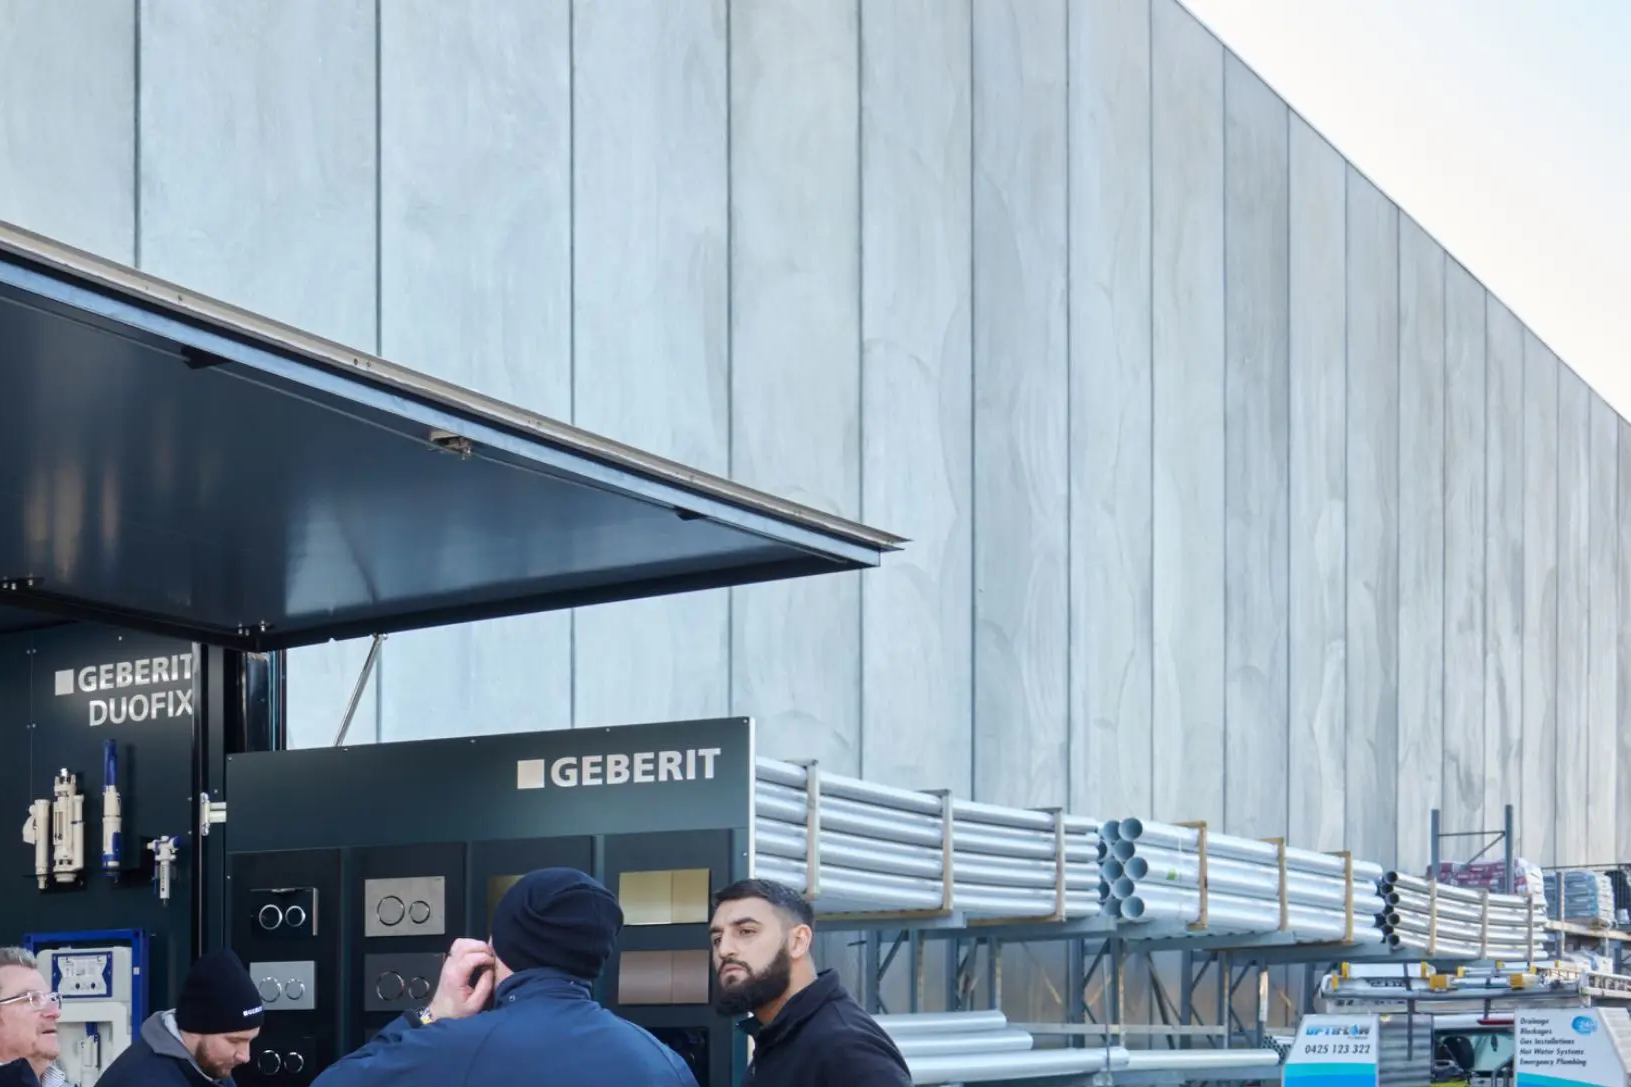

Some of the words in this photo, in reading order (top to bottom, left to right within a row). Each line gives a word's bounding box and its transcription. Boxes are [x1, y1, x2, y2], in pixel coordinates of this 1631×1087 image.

[88, 688, 193, 727] DUOFIX
[550, 747, 722, 788] GEBERIT
[1305, 1044, 1329, 1054] 0425
[1332, 1044, 1350, 1054] 123
[1352, 1044, 1371, 1054] 322
